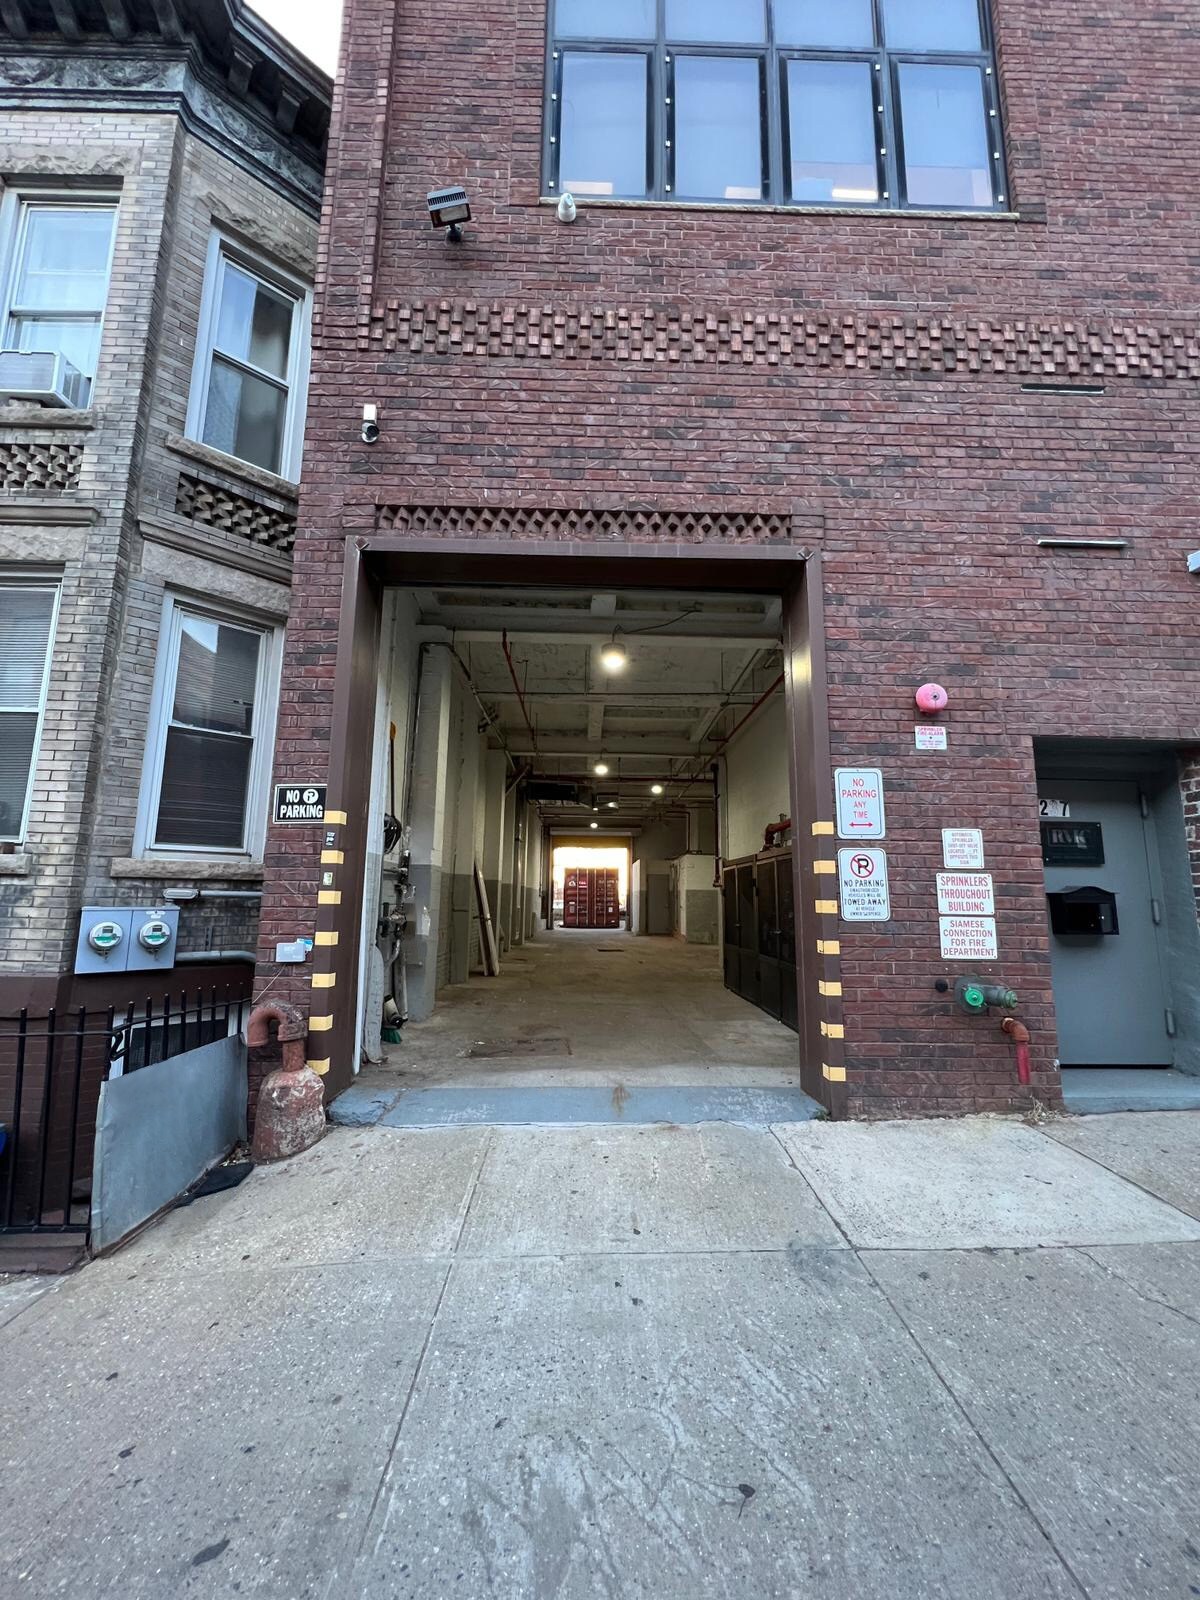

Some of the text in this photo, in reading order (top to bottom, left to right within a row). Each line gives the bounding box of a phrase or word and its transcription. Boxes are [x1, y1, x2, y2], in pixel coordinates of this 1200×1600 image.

[852, 778, 864, 786] NO
[286, 790, 300, 803] NO
[842, 790, 876, 798] PARKING
[280, 804, 323, 818] PARKING
[940, 876, 988, 886] SPRINKLERS
[939, 889, 990, 899] THROUGHOUT
[948, 902, 984, 912] BUILDING
[944, 948, 994, 956] DEPARTMENT
